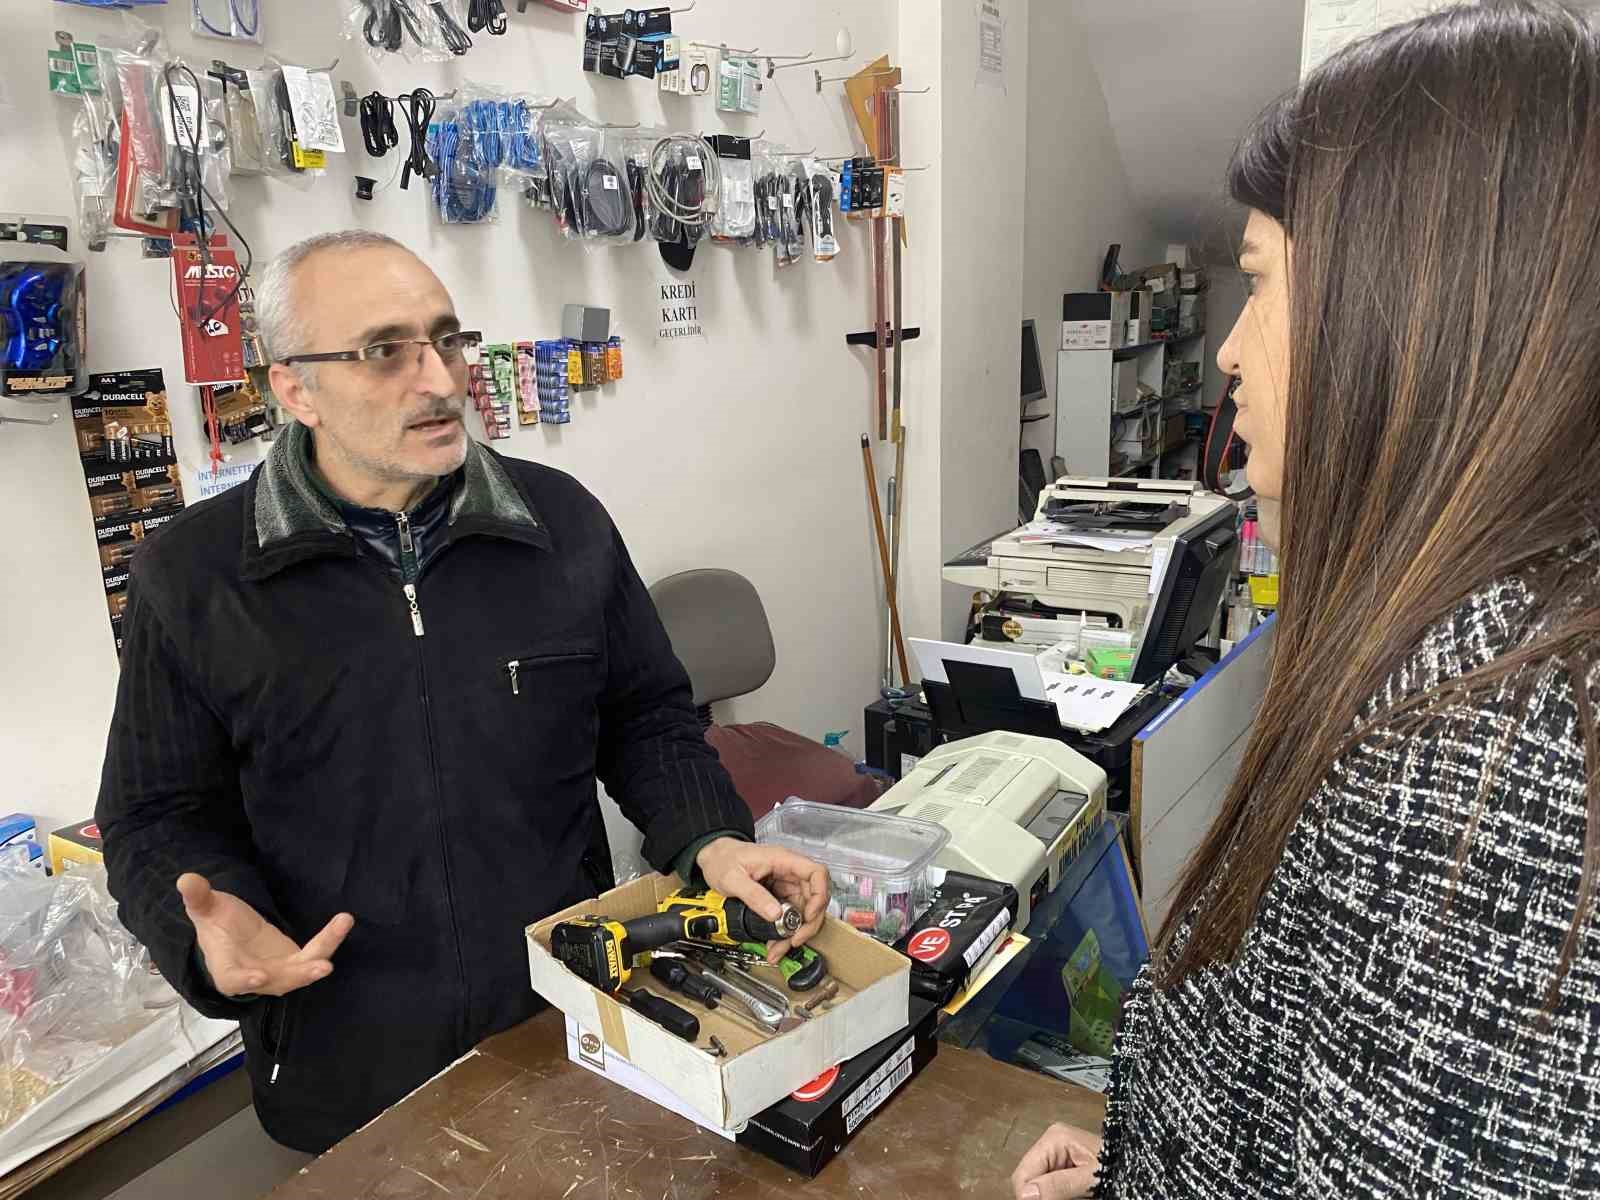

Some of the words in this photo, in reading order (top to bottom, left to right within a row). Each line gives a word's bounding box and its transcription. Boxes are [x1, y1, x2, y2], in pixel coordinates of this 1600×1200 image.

[661, 281, 696, 299] KREDİ
[662, 306, 697, 322] KARTI
[659, 323, 702, 339] GEÇERLİDİR
[102, 393, 145, 401] DURACELL
[136, 466, 167, 476] DURACELL
[88, 473, 121, 484] DURACELL
[98, 524, 130, 535] DURACELL
[105, 573, 129, 584] DURAC
[913, 935, 947, 955] VE
